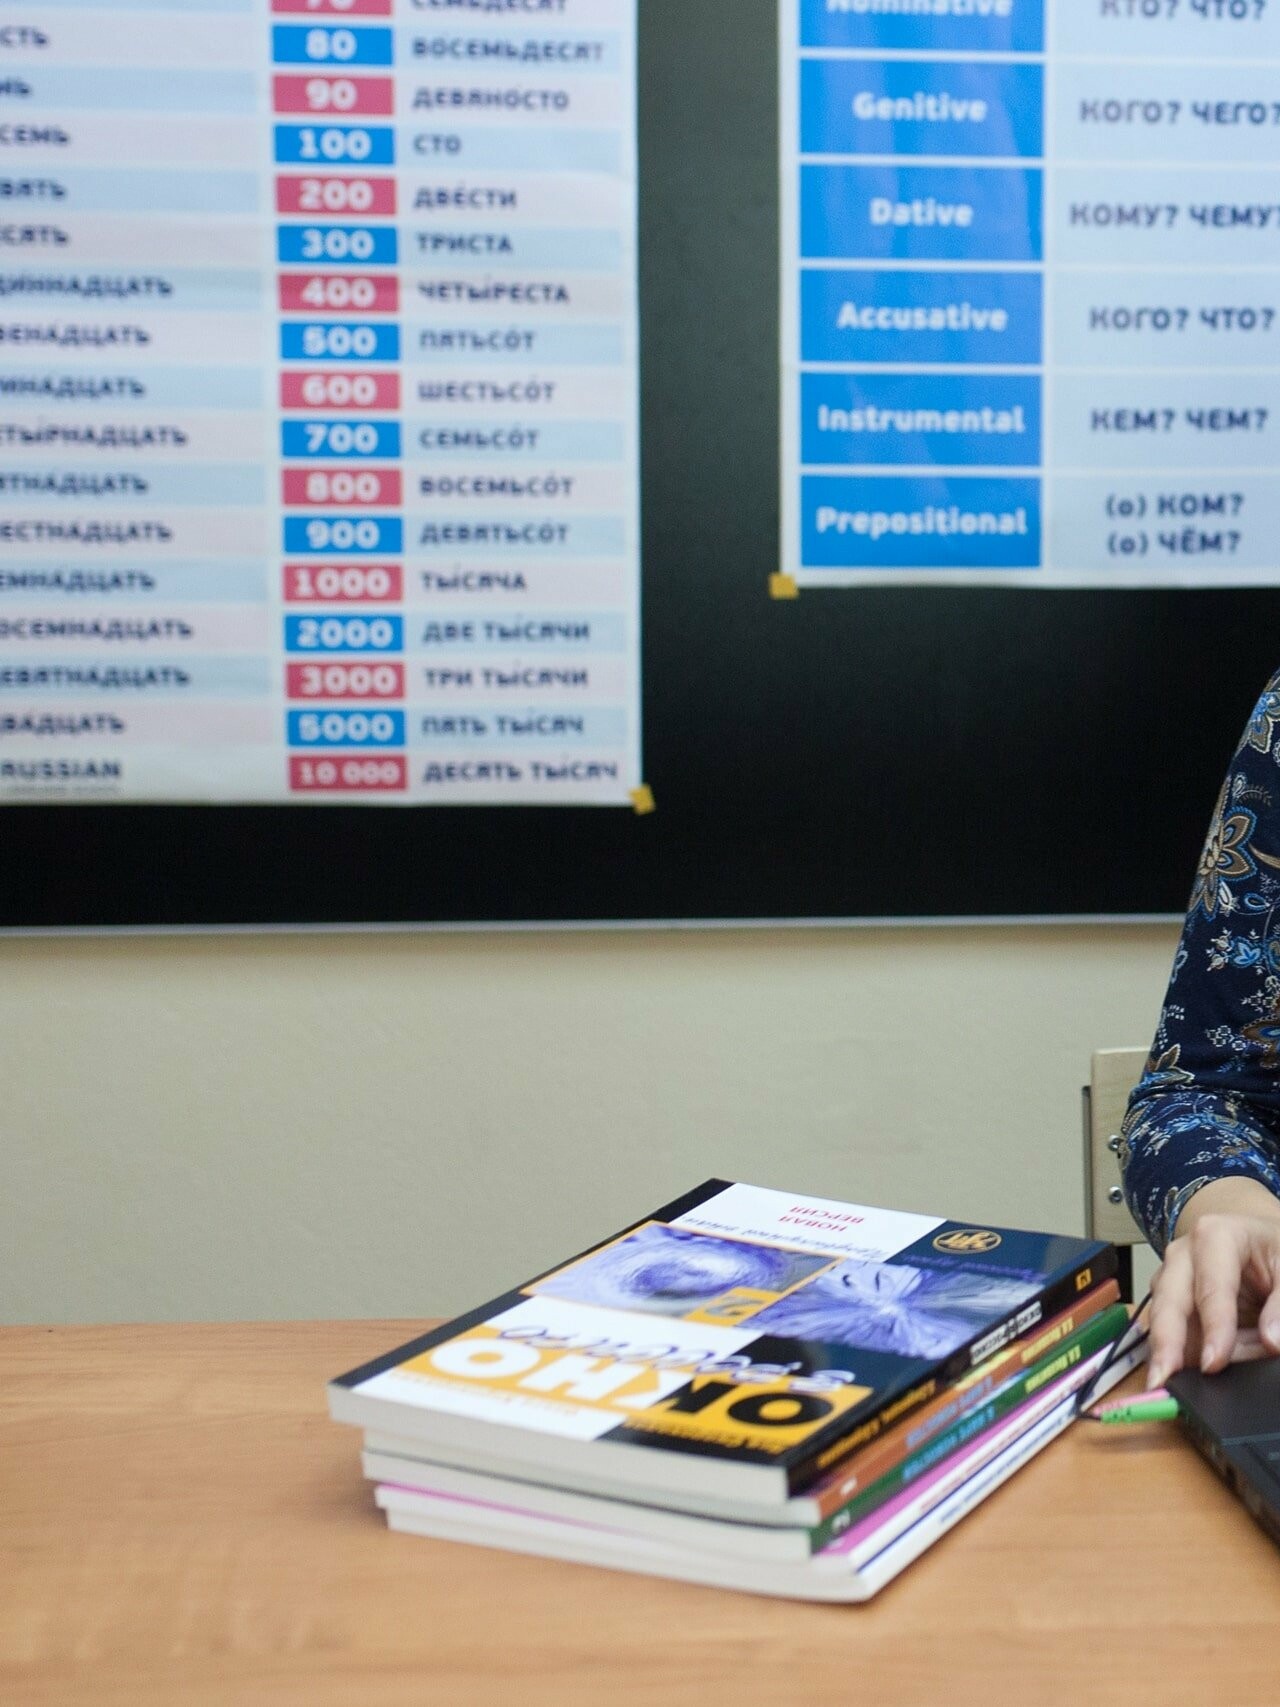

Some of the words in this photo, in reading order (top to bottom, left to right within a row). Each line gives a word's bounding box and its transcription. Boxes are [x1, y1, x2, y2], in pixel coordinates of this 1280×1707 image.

[1100, 0, 1178, 20] КТО?
[1191, 0, 1266, 20] ЧТО?
[305, 29, 357, 60] 80
[305, 80, 357, 109] 90
[853, 92, 988, 121] Genitive
[1080, 100, 1180, 124] КОГО?
[300, 130, 372, 159] 100
[413, 134, 462, 155] СТО
[300, 180, 373, 209] 200
[870, 199, 973, 227] Dative
[1070, 204, 1177, 228] КОМУ?
[301, 231, 374, 259] 300
[416, 232, 514, 254] ТРИСТА
[301, 279, 375, 307] 400
[837, 302, 1009, 331] Accusative
[1090, 307, 1189, 331] КОГО?
[1200, 308, 1275, 331] ЧТО?
[302, 328, 376, 357] 500
[302, 376, 376, 404] 600
[818, 405, 1026, 433] Instrumental
[1091, 409, 1176, 432] КЕМ?
[1186, 409, 1268, 432] ЧЕМ?
[306, 425, 379, 453] 700
[306, 473, 380, 501] 800
[1106, 494, 1147, 519] (о)
[1157, 493, 1244, 517] КОМ?
[306, 521, 381, 550] 900
[817, 506, 1028, 539] Prepositional
[1107, 531, 1149, 557] (о)
[1159, 529, 1242, 555] ЧЁМ?
[294, 569, 391, 598] 1000
[297, 619, 394, 648] 2000
[422, 622, 475, 644] ДВЕ
[301, 667, 398, 696] 3000
[423, 668, 475, 689] ТРИ
[298, 715, 395, 742] 5000
[421, 714, 488, 736] ПЯТЬ
[422, 760, 523, 783] ДЕСЯТЬ
[777, 1215, 847, 1233] НОВАЯ
[789, 1205, 866, 1225] ВЕРСИЯ
[430, 1336, 834, 1426] ОКНО
